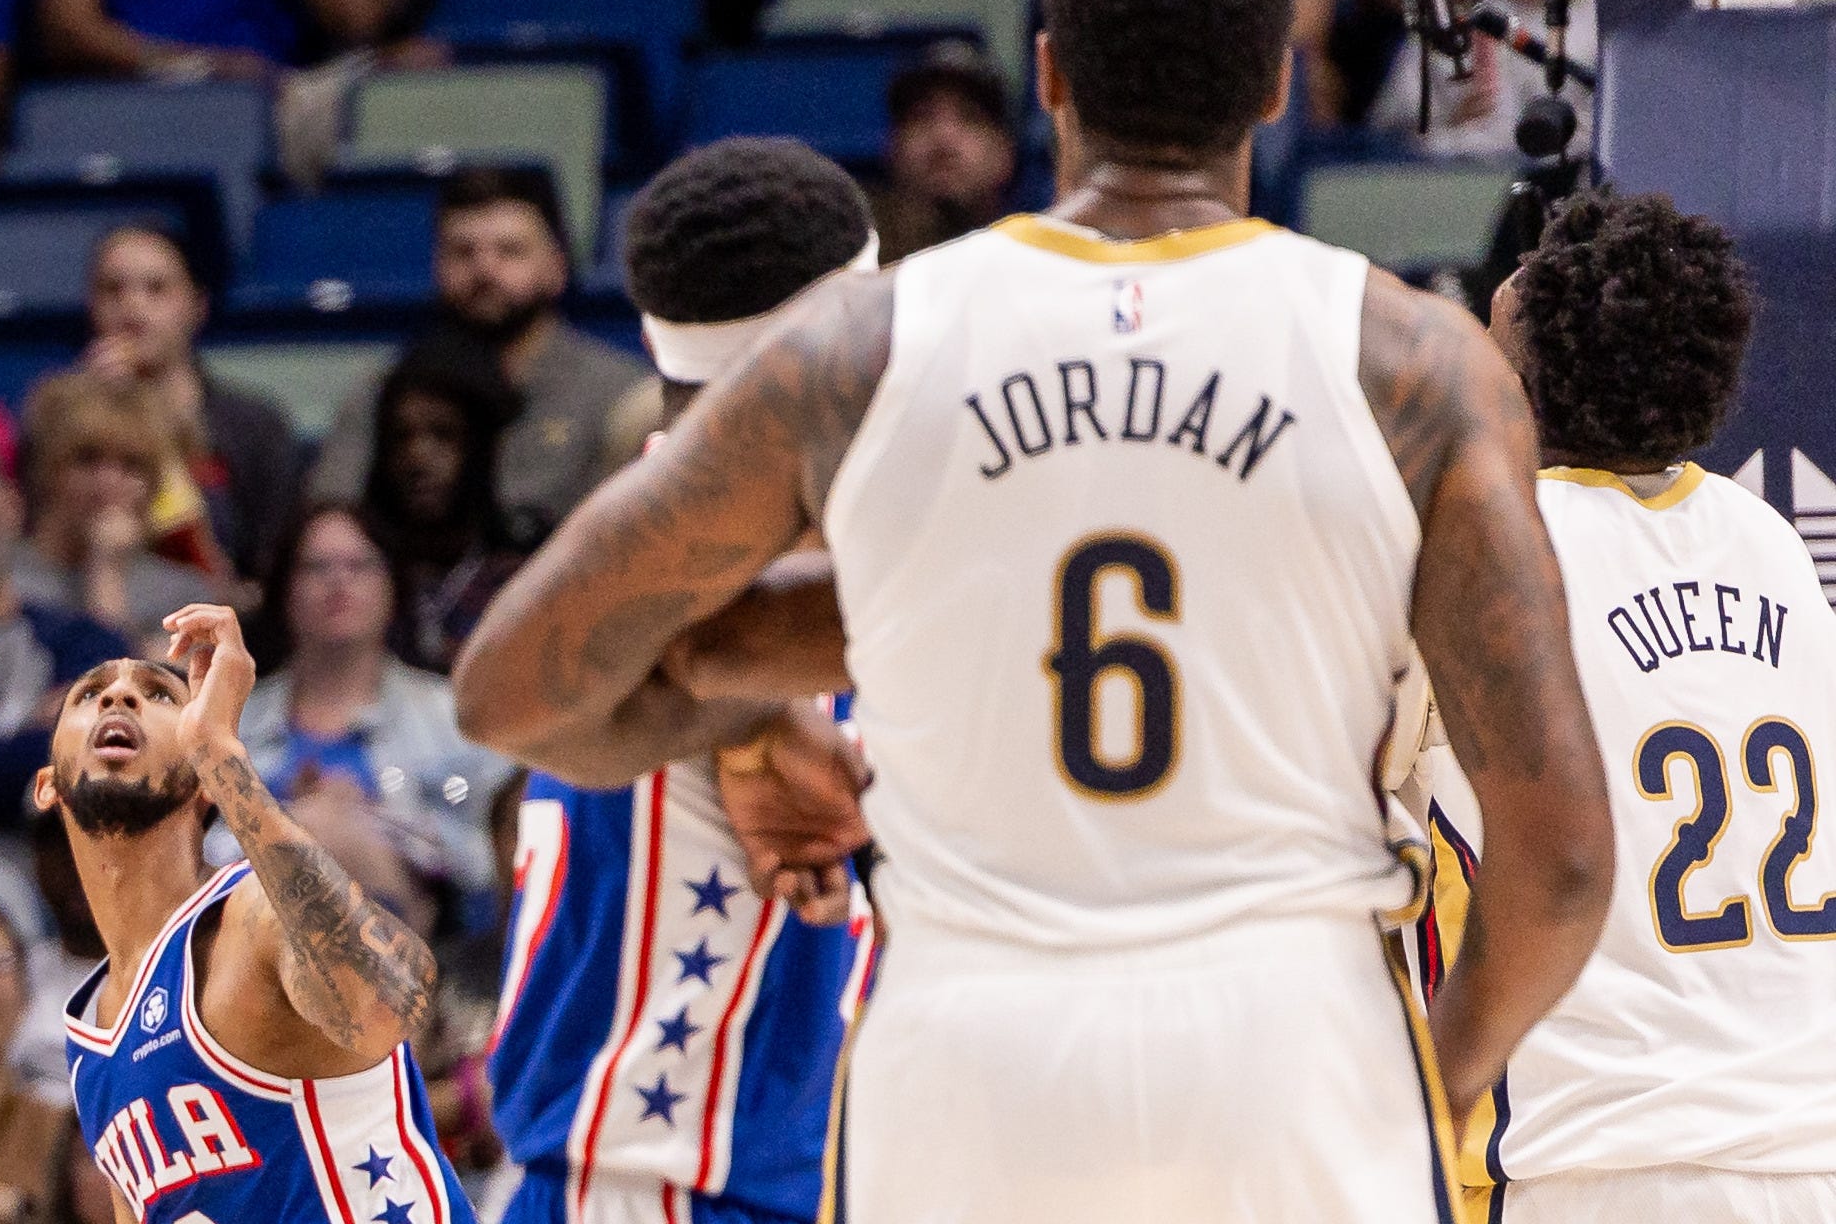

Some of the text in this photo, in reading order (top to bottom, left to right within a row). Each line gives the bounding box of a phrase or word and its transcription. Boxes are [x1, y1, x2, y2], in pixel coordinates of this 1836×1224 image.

[963, 352, 1299, 482] JORDAN
[1039, 525, 1185, 805] 6
[1607, 580, 1789, 674] QUEEN
[1631, 713, 1836, 954] 22
[94, 1081, 263, 1224] HILA
